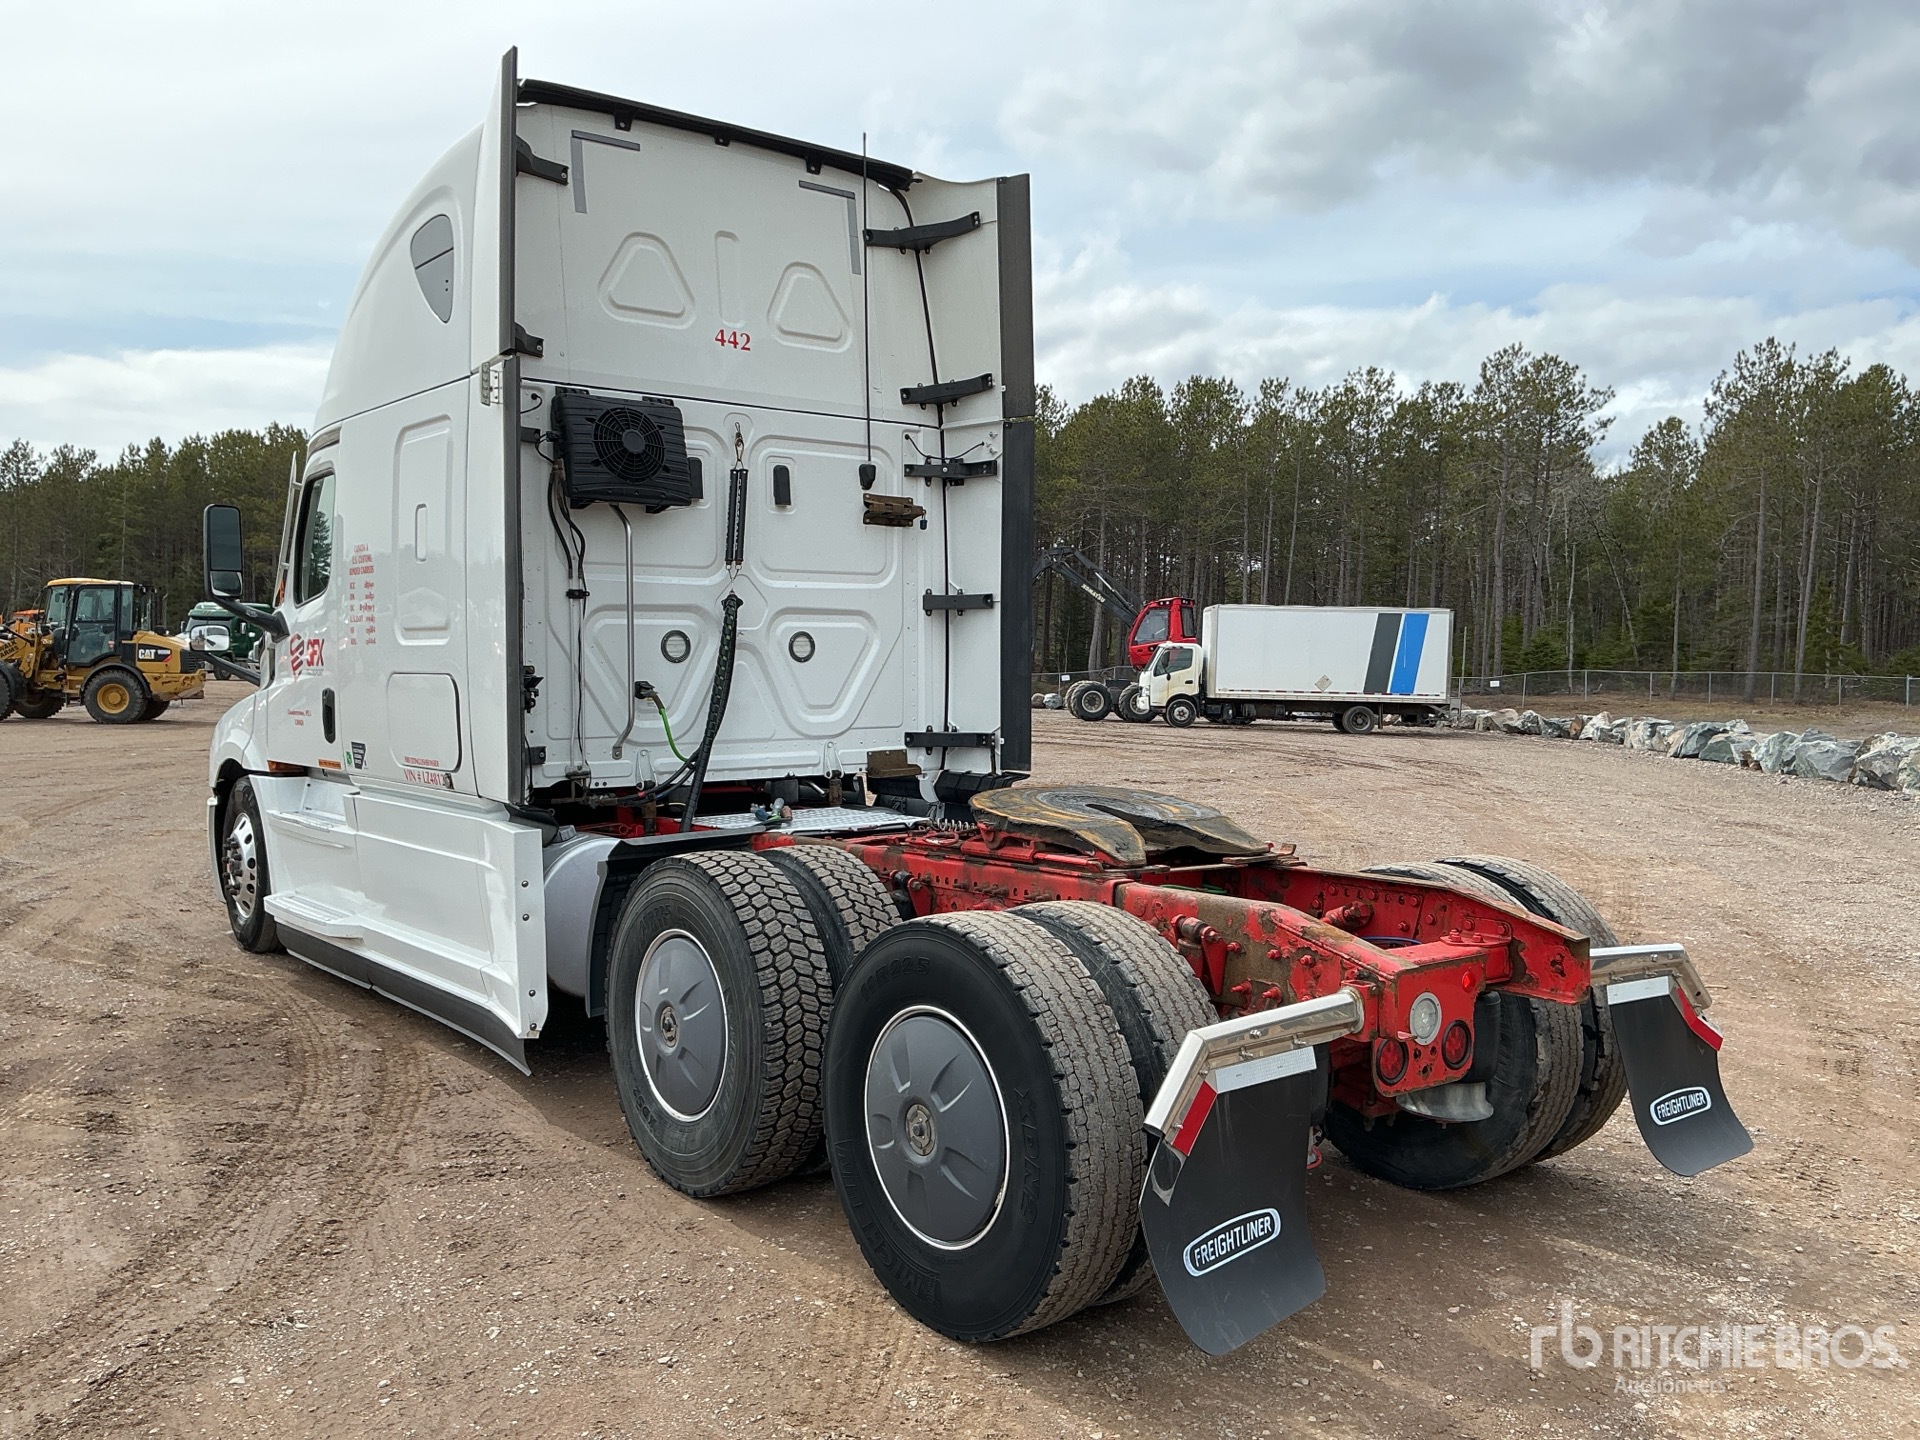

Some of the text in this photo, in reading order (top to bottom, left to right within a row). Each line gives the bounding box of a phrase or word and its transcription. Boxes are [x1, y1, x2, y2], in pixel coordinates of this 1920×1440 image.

[714, 329, 751, 351] 442
[138, 649, 155, 659] CAT
[403, 769, 417, 782] VIN
[859, 956, 931, 1002] 11R22.5
[1656, 1092, 1706, 1119] FREIGHTLINER
[1013, 1086, 1041, 1225] XDN2
[1194, 1216, 1272, 1268] FREIGHTLINER
